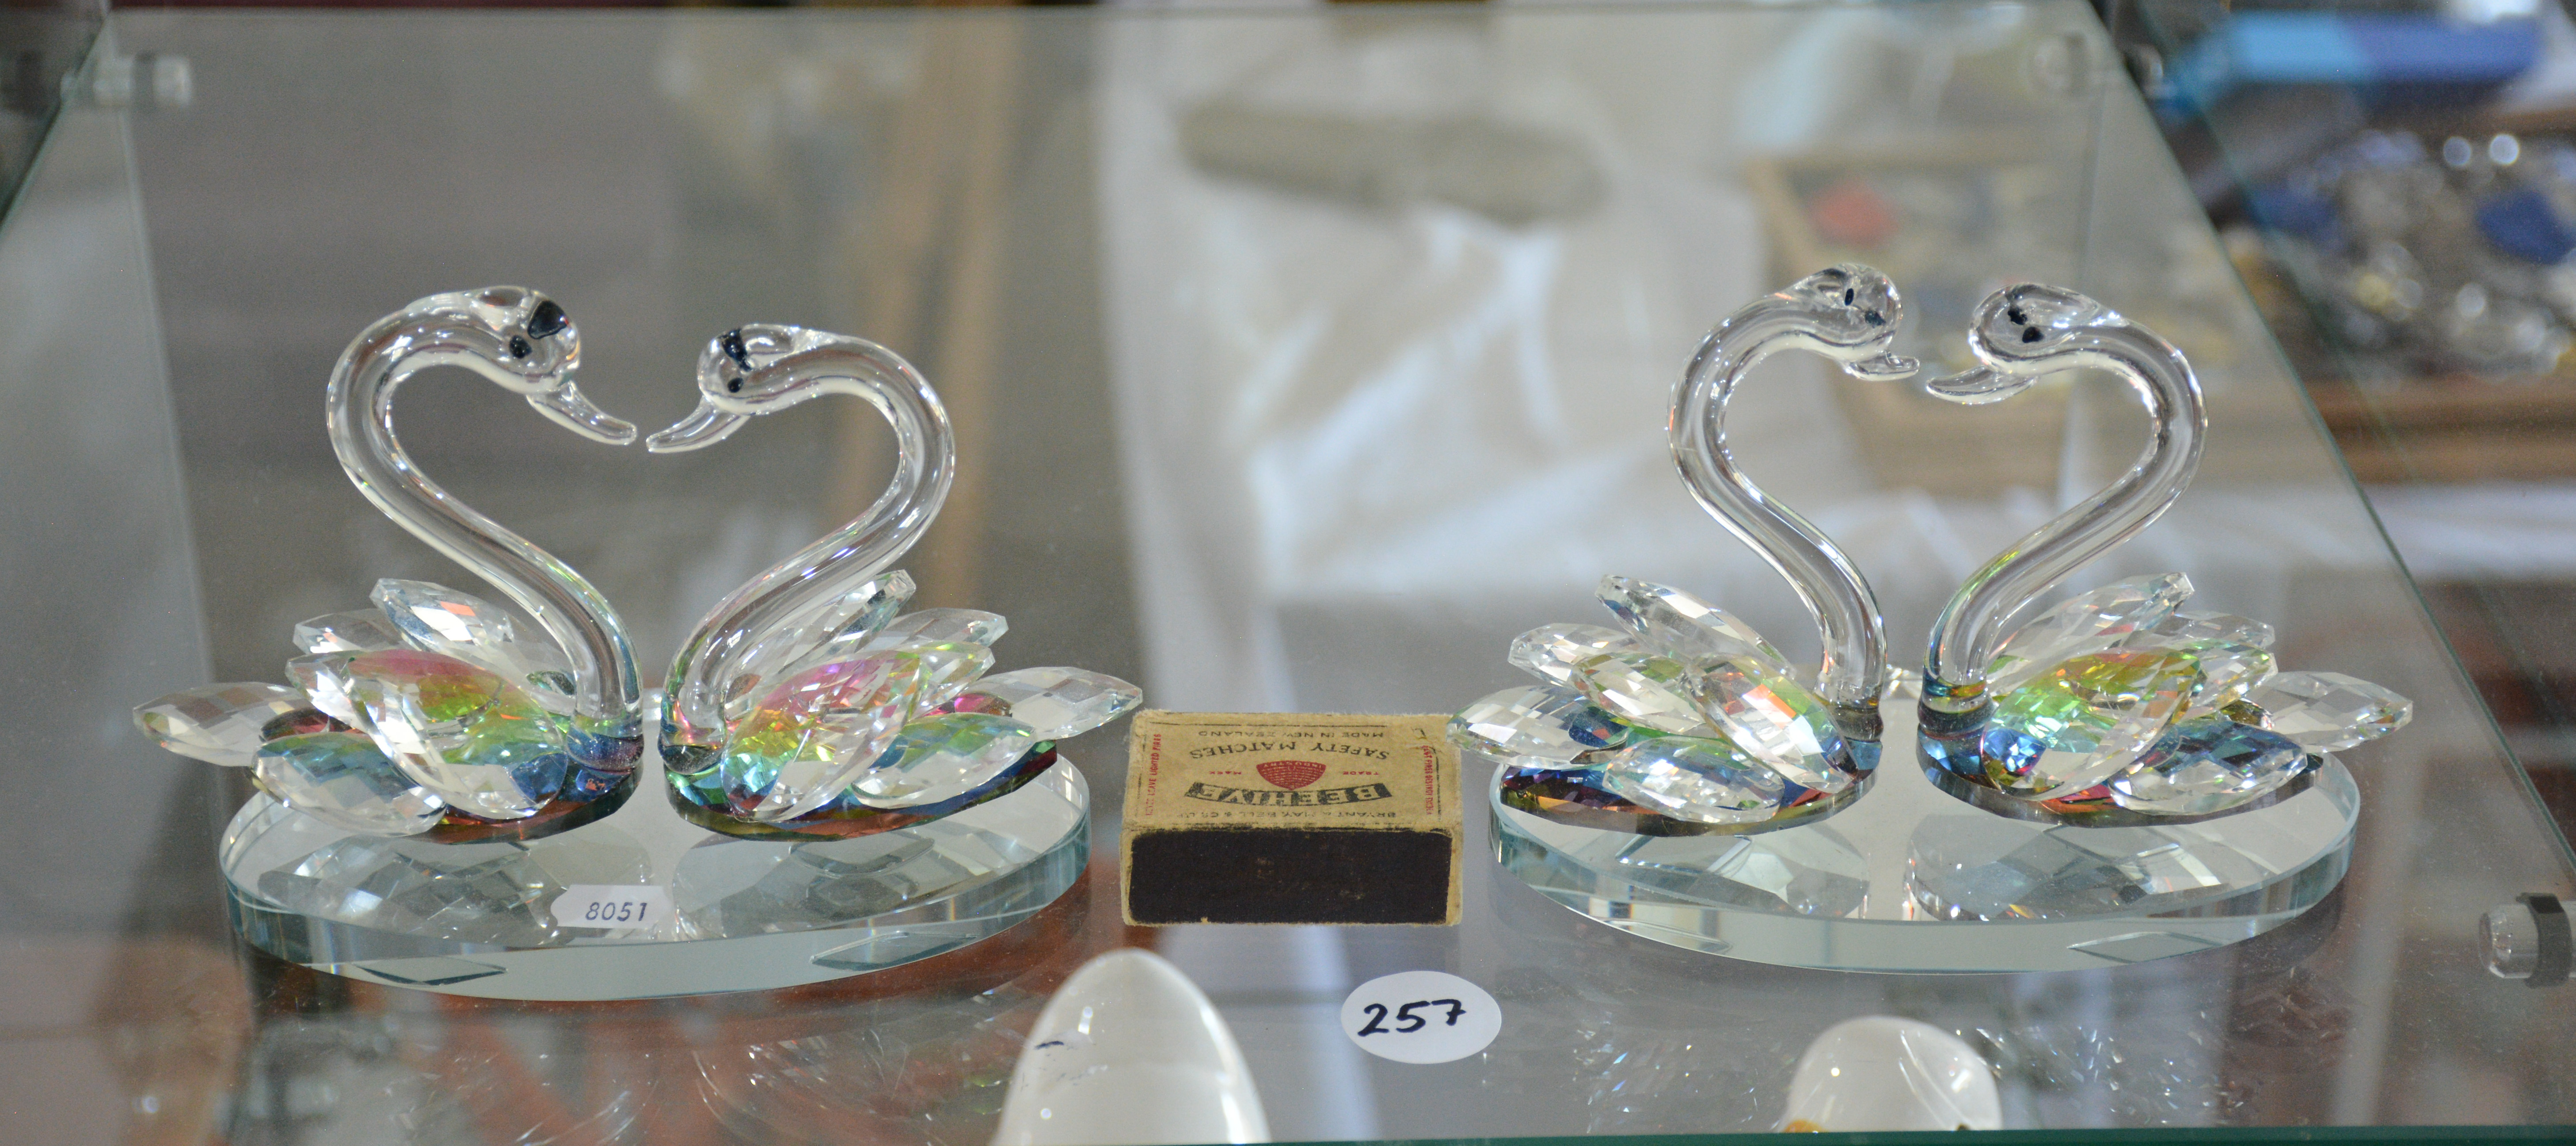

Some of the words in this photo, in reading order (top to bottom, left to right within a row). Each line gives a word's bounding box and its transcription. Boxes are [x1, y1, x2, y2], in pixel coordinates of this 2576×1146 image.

[1152, 733, 1162, 751] FIRES
[1189, 742, 1296, 759] MATCHES
[1310, 742, 1389, 760] SAFETY
[1149, 752, 1160, 776] LIGHTED
[1425, 774, 1434, 796] DESTROY
[1197, 785, 1381, 806] BEEHIVE
[585, 902, 648, 922] 8051
[1357, 998, 1466, 1037] 257
